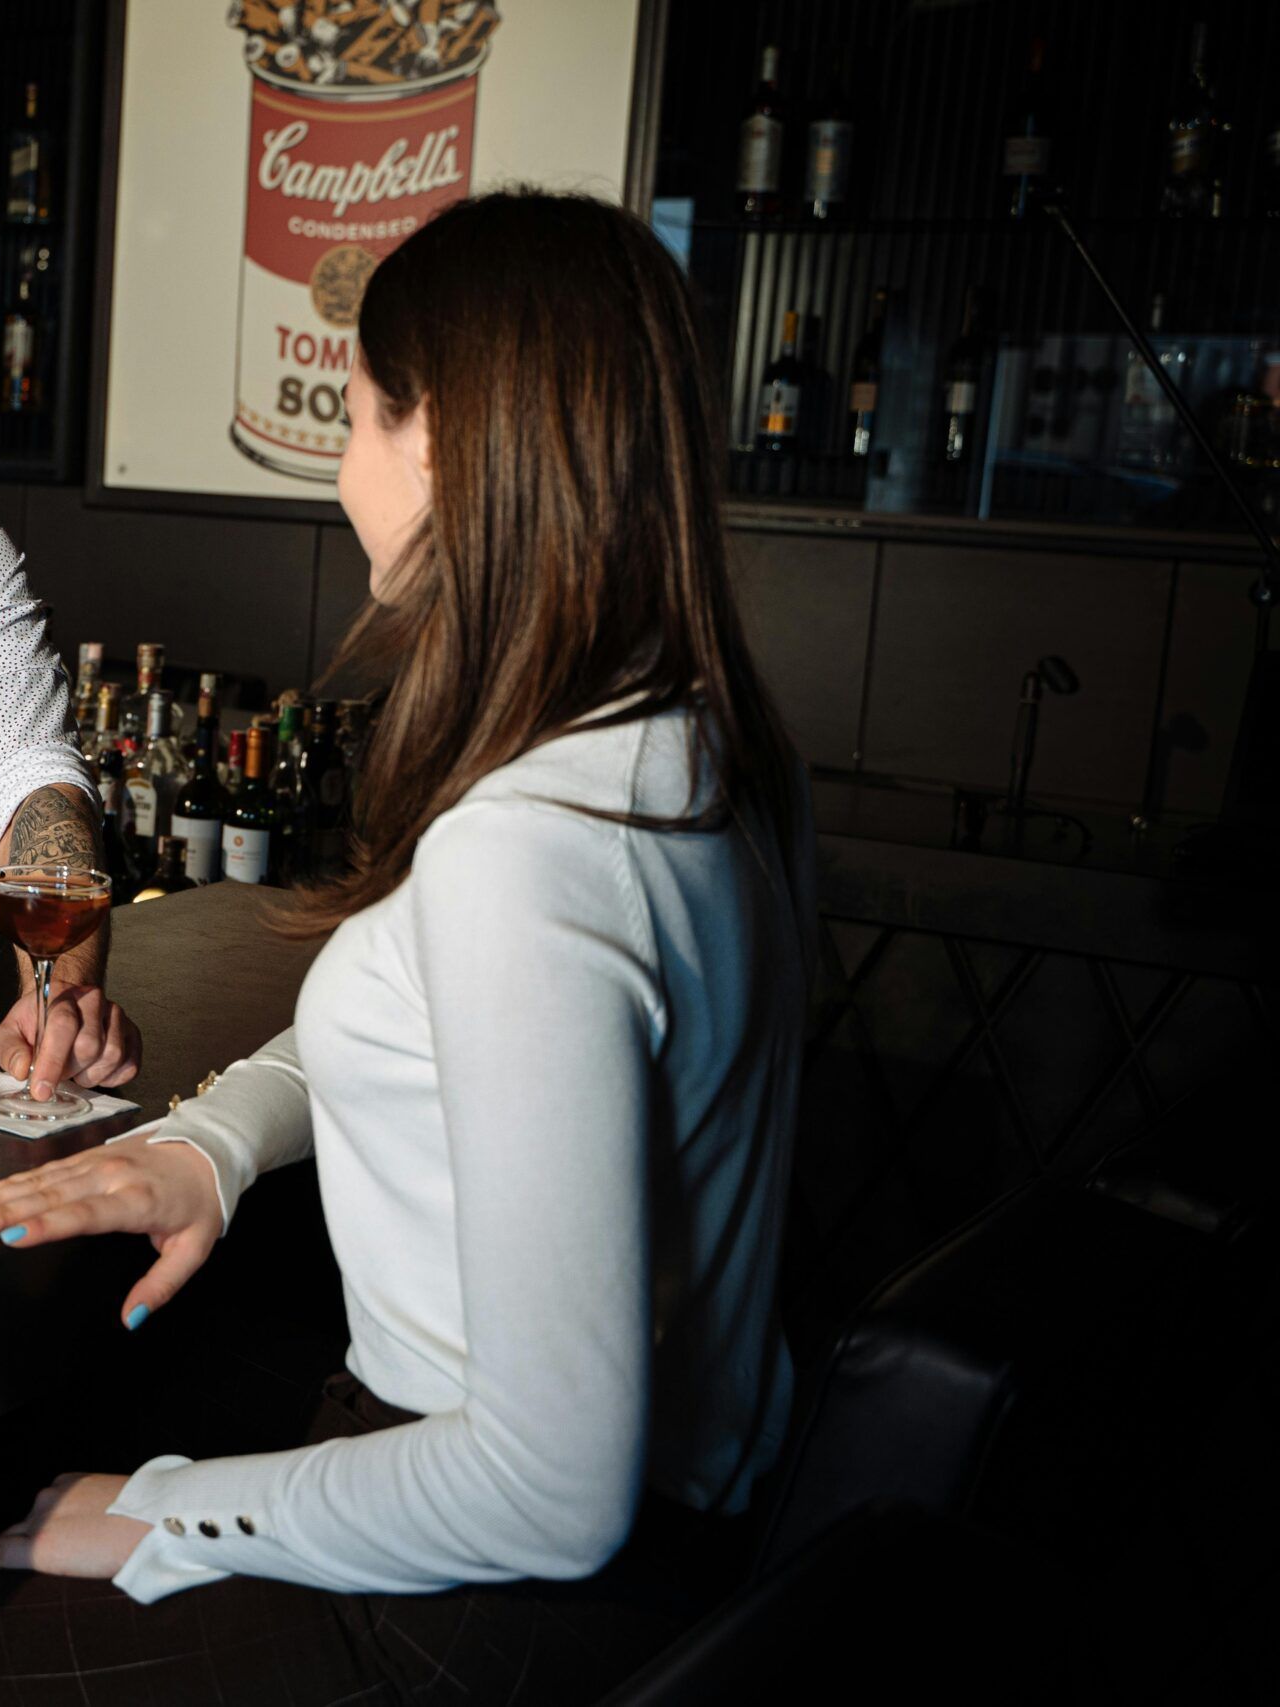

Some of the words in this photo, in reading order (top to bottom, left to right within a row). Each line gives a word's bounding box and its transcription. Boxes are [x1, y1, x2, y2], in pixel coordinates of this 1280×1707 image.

[258, 120, 464, 218] Campbell's
[287, 215, 418, 241] CONDENSED
[275, 323, 349, 371] TOM
[277, 376, 340, 424] SO
